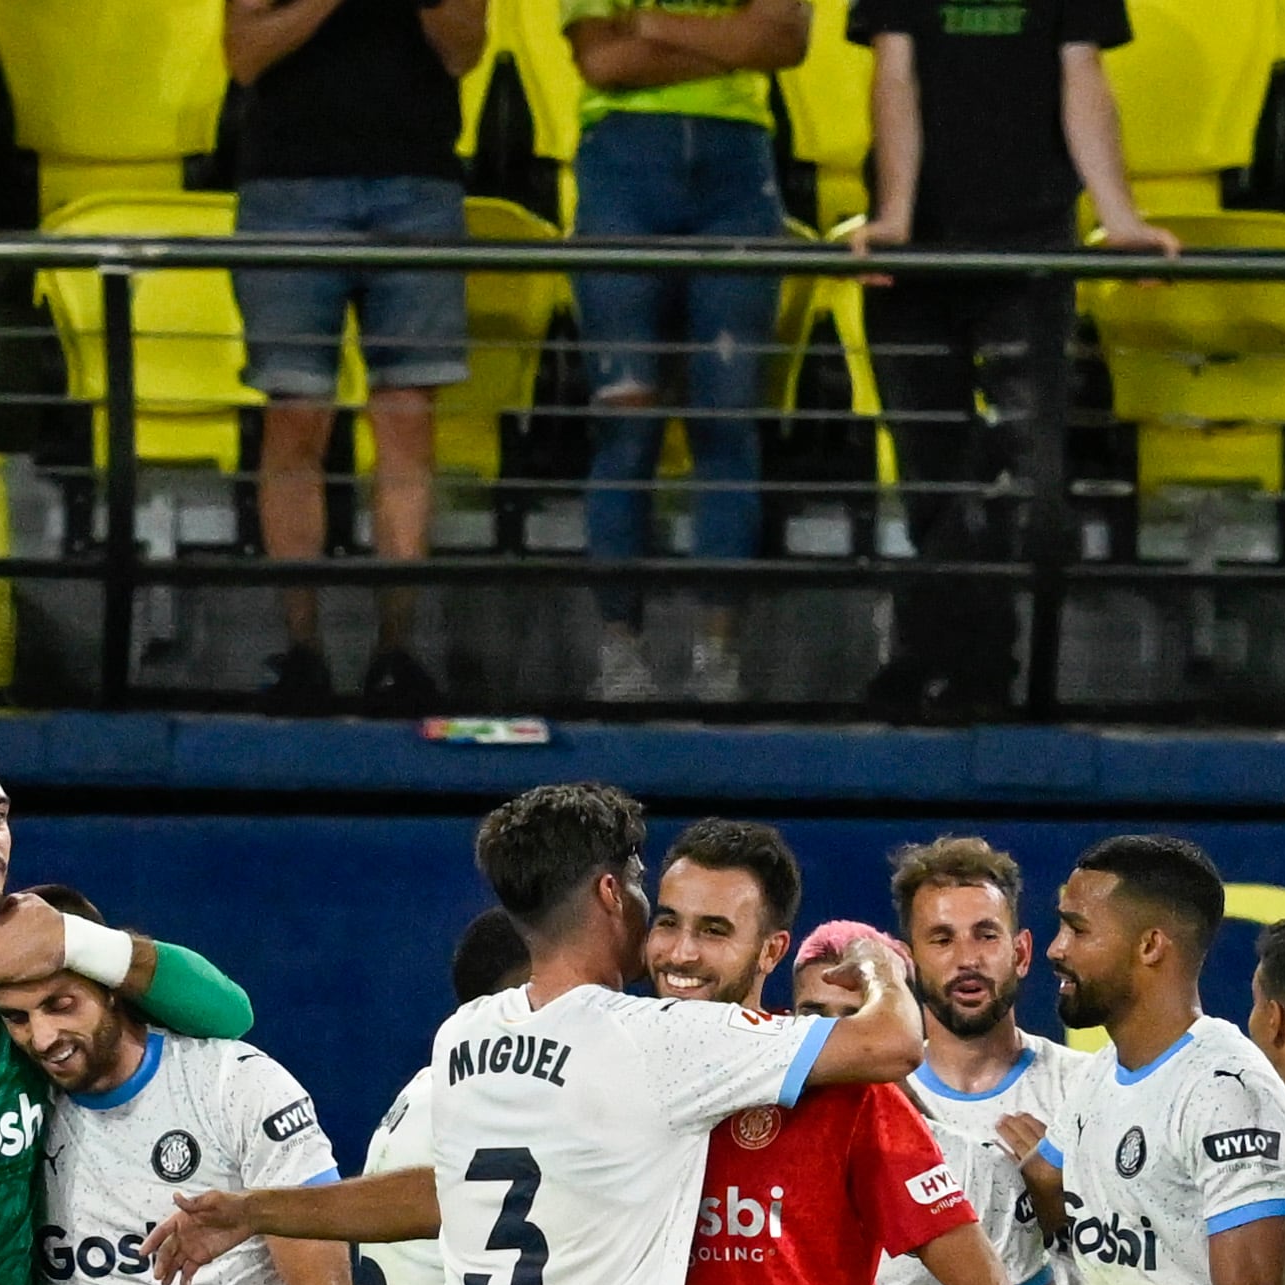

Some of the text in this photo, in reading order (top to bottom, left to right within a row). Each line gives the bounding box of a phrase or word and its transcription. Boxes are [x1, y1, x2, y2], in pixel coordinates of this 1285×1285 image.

[449, 1035, 571, 1088] MIGUEL
[1215, 1134, 1267, 1157] HYLO
[39, 1222, 156, 1280] Gos
